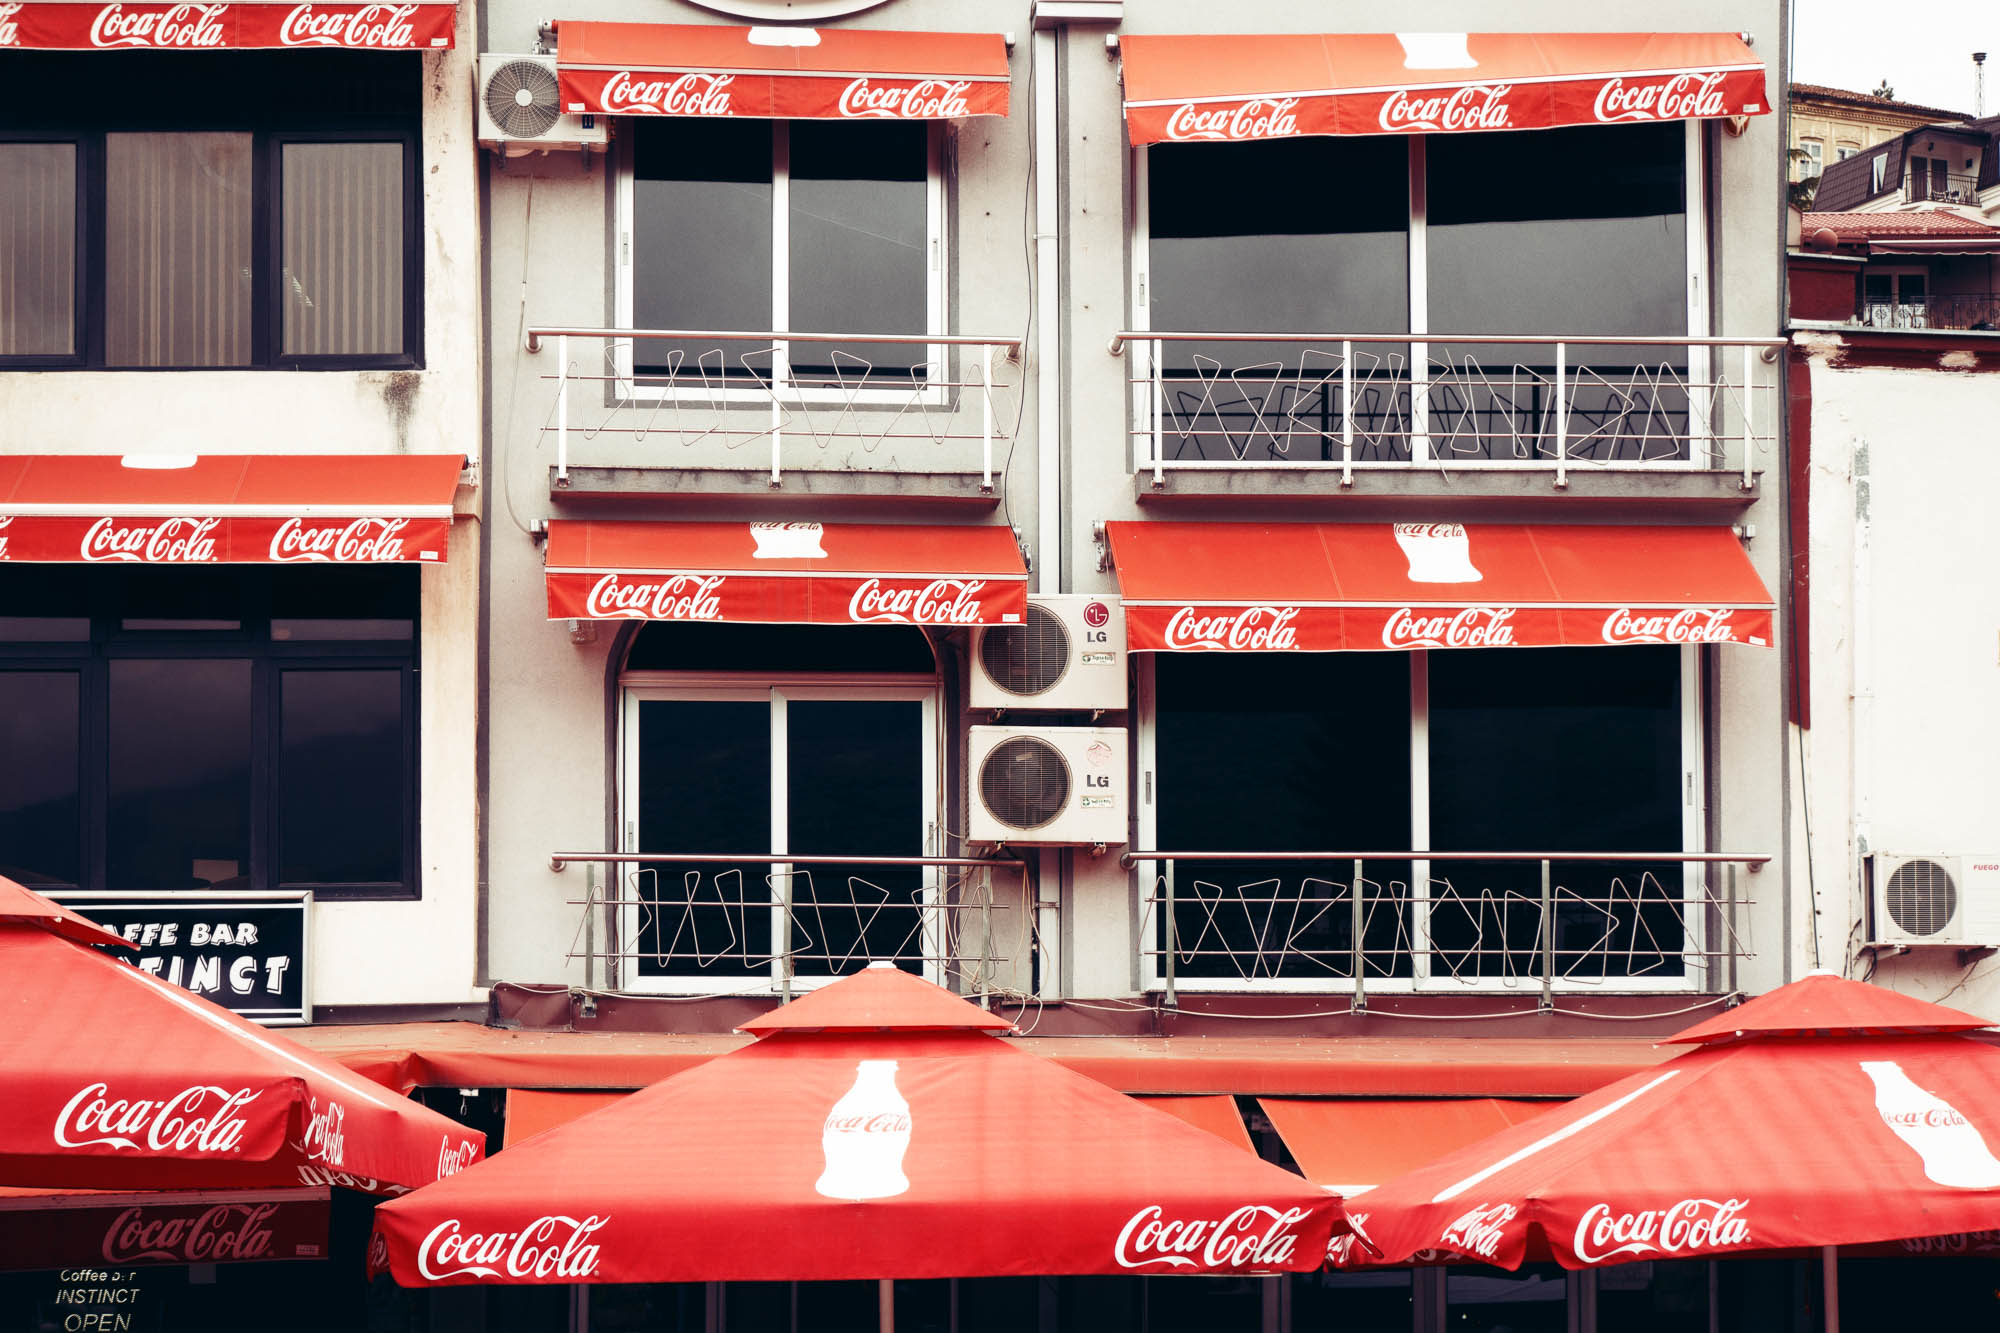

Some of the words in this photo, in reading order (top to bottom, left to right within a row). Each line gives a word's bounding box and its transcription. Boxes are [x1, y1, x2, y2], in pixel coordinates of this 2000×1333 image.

[90, 3, 226, 47] Coca-Cola
[280, 3, 417, 47] Coca-Cola
[600, 71, 736, 115] Coca-Cola
[838, 78, 972, 118] Coca-Cola
[1377, 83, 1513, 130] Coca-Cola
[1590, 71, 1728, 122] Coca-Cola
[1166, 97, 1302, 139] Coca-Cola
[80, 516, 220, 561] Coca-Cola
[268, 516, 411, 561] Coca-Cola
[585, 573, 727, 620] Coca-Cola
[848, 578, 985, 623] Coca-Cola
[1087, 631, 1107, 643] LG
[1165, 606, 1301, 649] Coca-Cola
[1381, 606, 1519, 648] Coca-Cola
[1601, 608, 1738, 644] Coca-Cola
[1086, 774, 1109, 788] LG
[190, 922, 258, 947] BAR
[54, 1083, 263, 1152] Coca-Cola
[102, 1203, 280, 1264] Coca-Cola
[418, 1215, 611, 1281] Coca-Cola
[1114, 1205, 1313, 1268] Coca-Cola
[1574, 1199, 1750, 1263] Coca-Cola
[55, 1288, 141, 1304] INSTINCT
[60, 1269, 108, 1282] Coffee
[64, 1313, 132, 1333] OPEN
